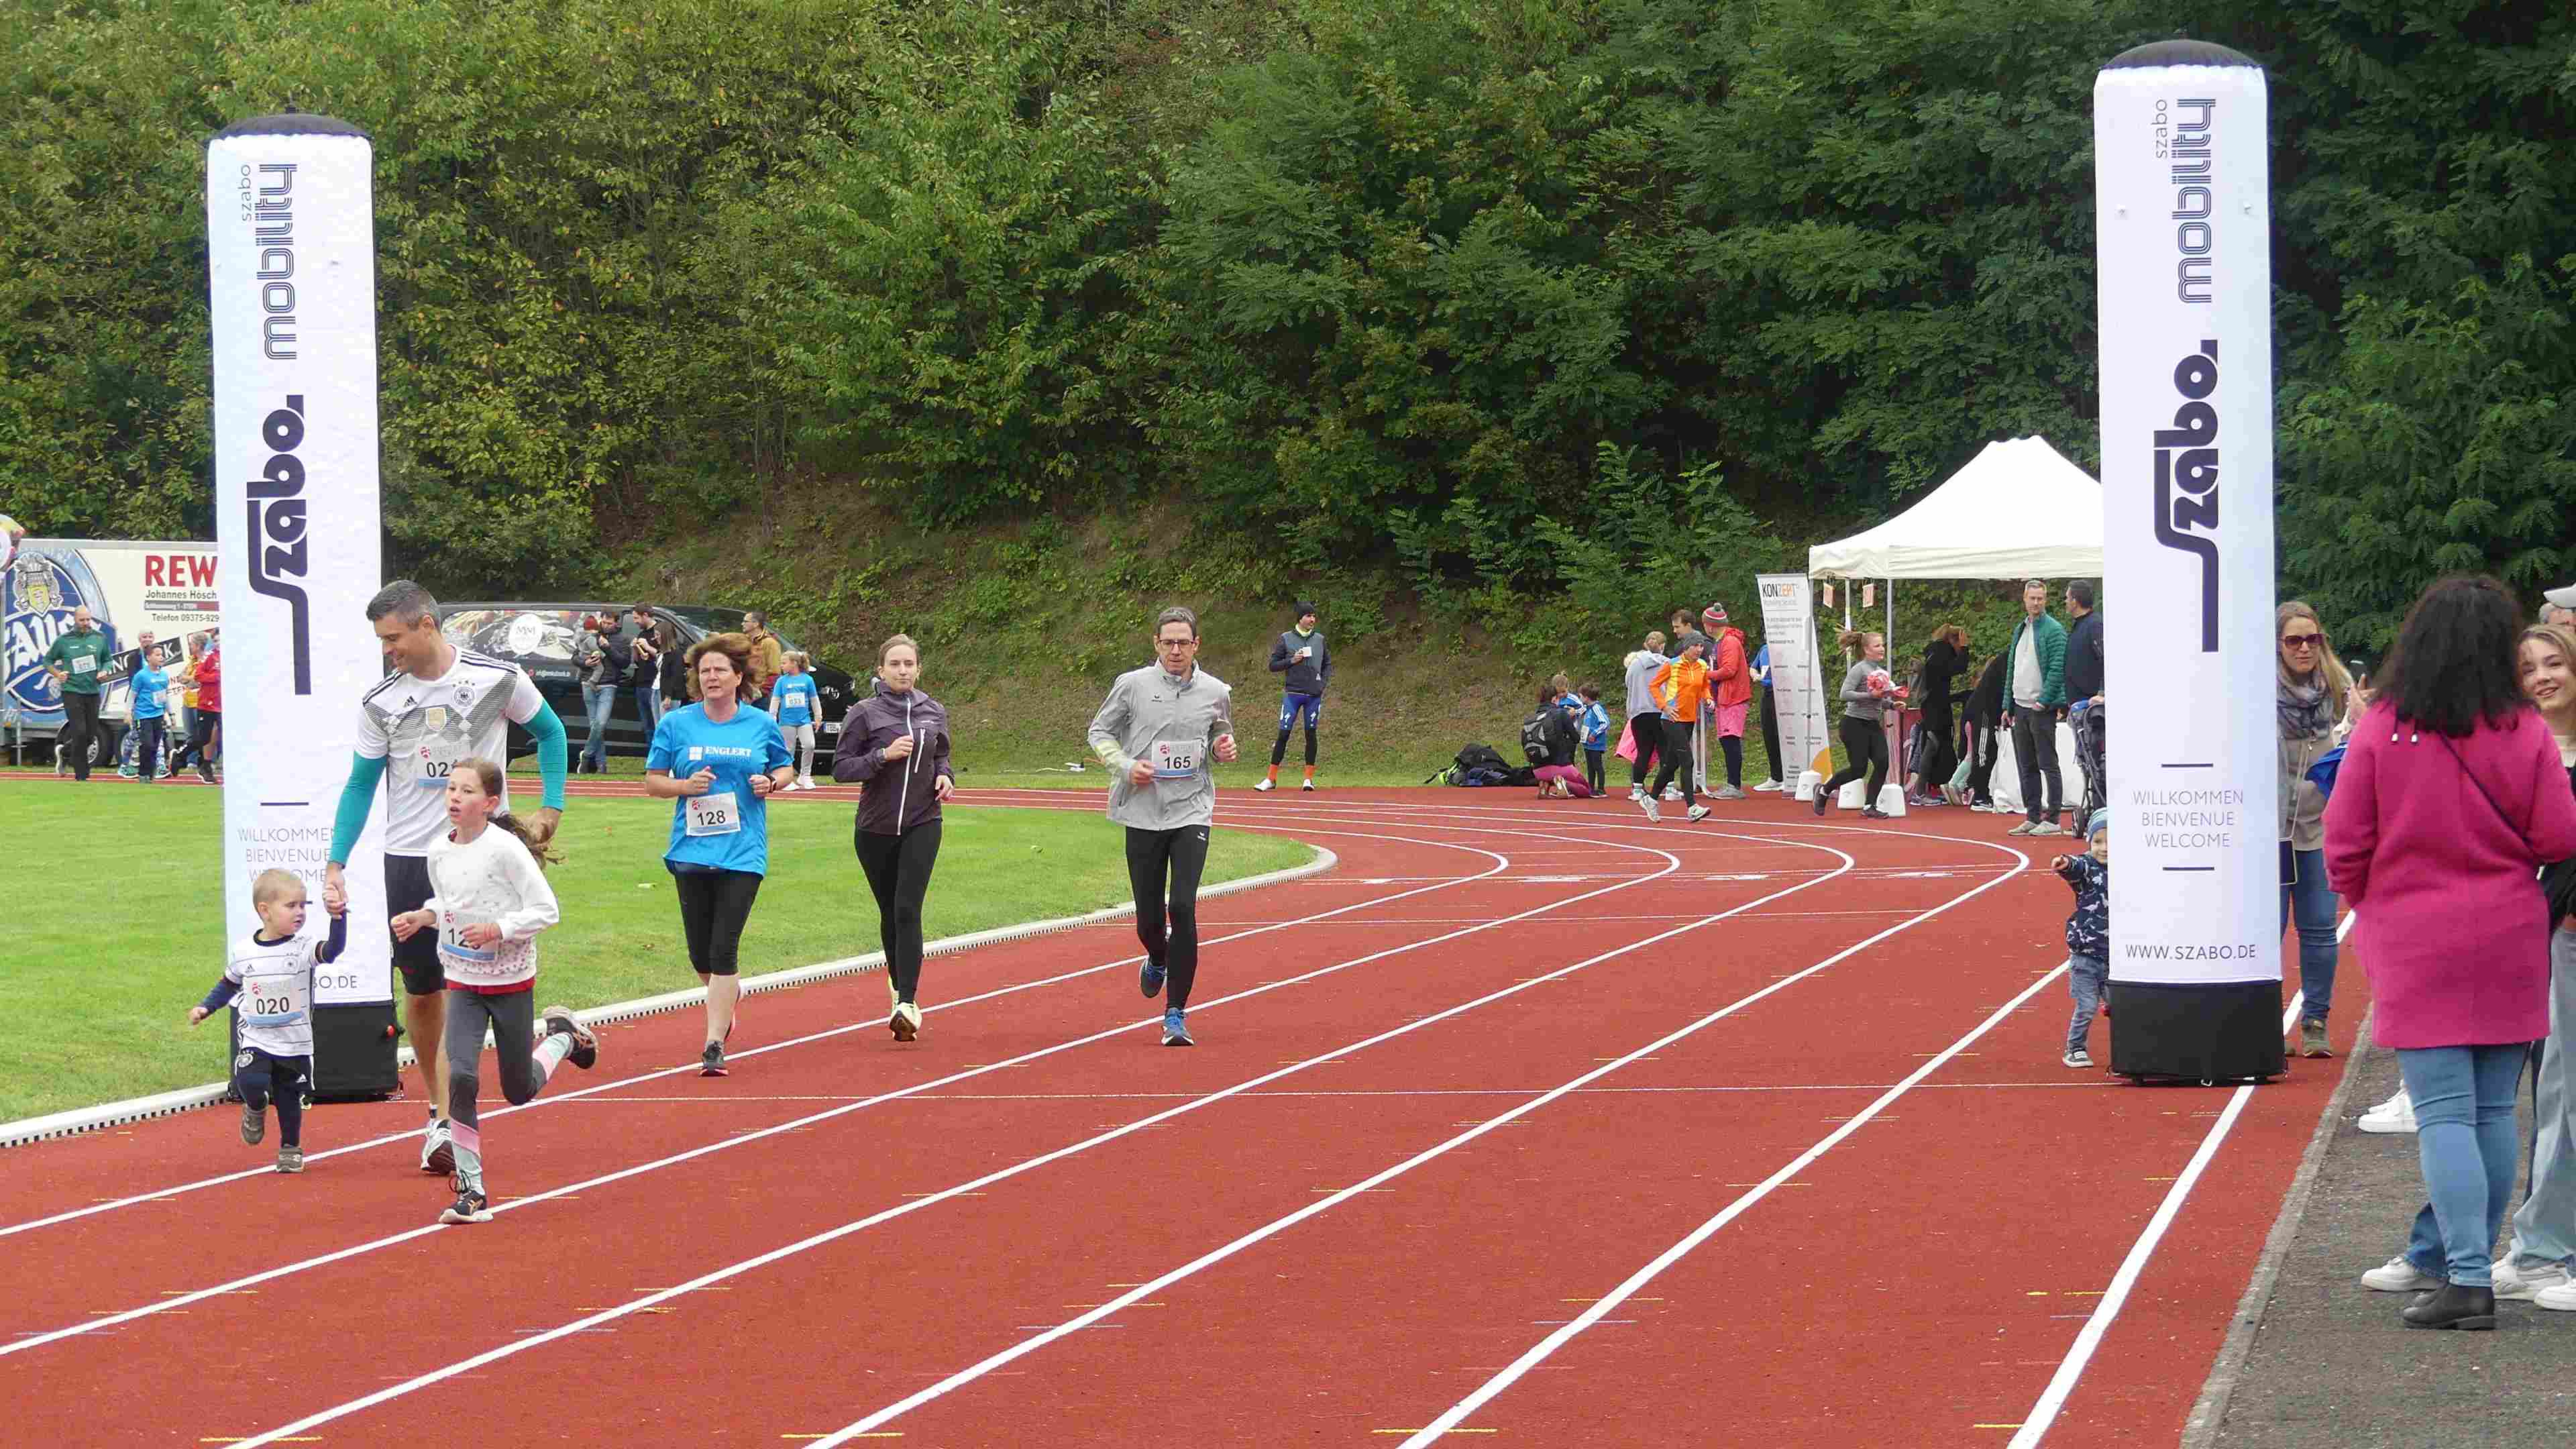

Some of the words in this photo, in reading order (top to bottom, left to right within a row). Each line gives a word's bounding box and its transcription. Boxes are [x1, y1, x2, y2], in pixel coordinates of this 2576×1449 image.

[2152, 99, 2168, 159] szabo
[237, 164, 252, 222] szabo
[2171, 99, 2216, 303] mobility
[254, 164, 298, 360] mobility
[145, 590, 188, 599] Johannes
[152, 612, 179, 622] Telefon
[705, 745, 752, 757] ENGLERT
[426, 759, 459, 778] 02
[1164, 755, 1191, 770] 165
[2132, 789, 2243, 806] WILLKOMMEN
[698, 810, 726, 826] 128
[2141, 811, 2235, 826] BIENVENUE
[237, 828, 334, 842] WILLKOMME
[2145, 833, 2233, 848] WELCOME
[447, 928, 481, 951] 12
[2125, 943, 2257, 960] WWW.SZABO.DE
[256, 996, 290, 1015] 020
